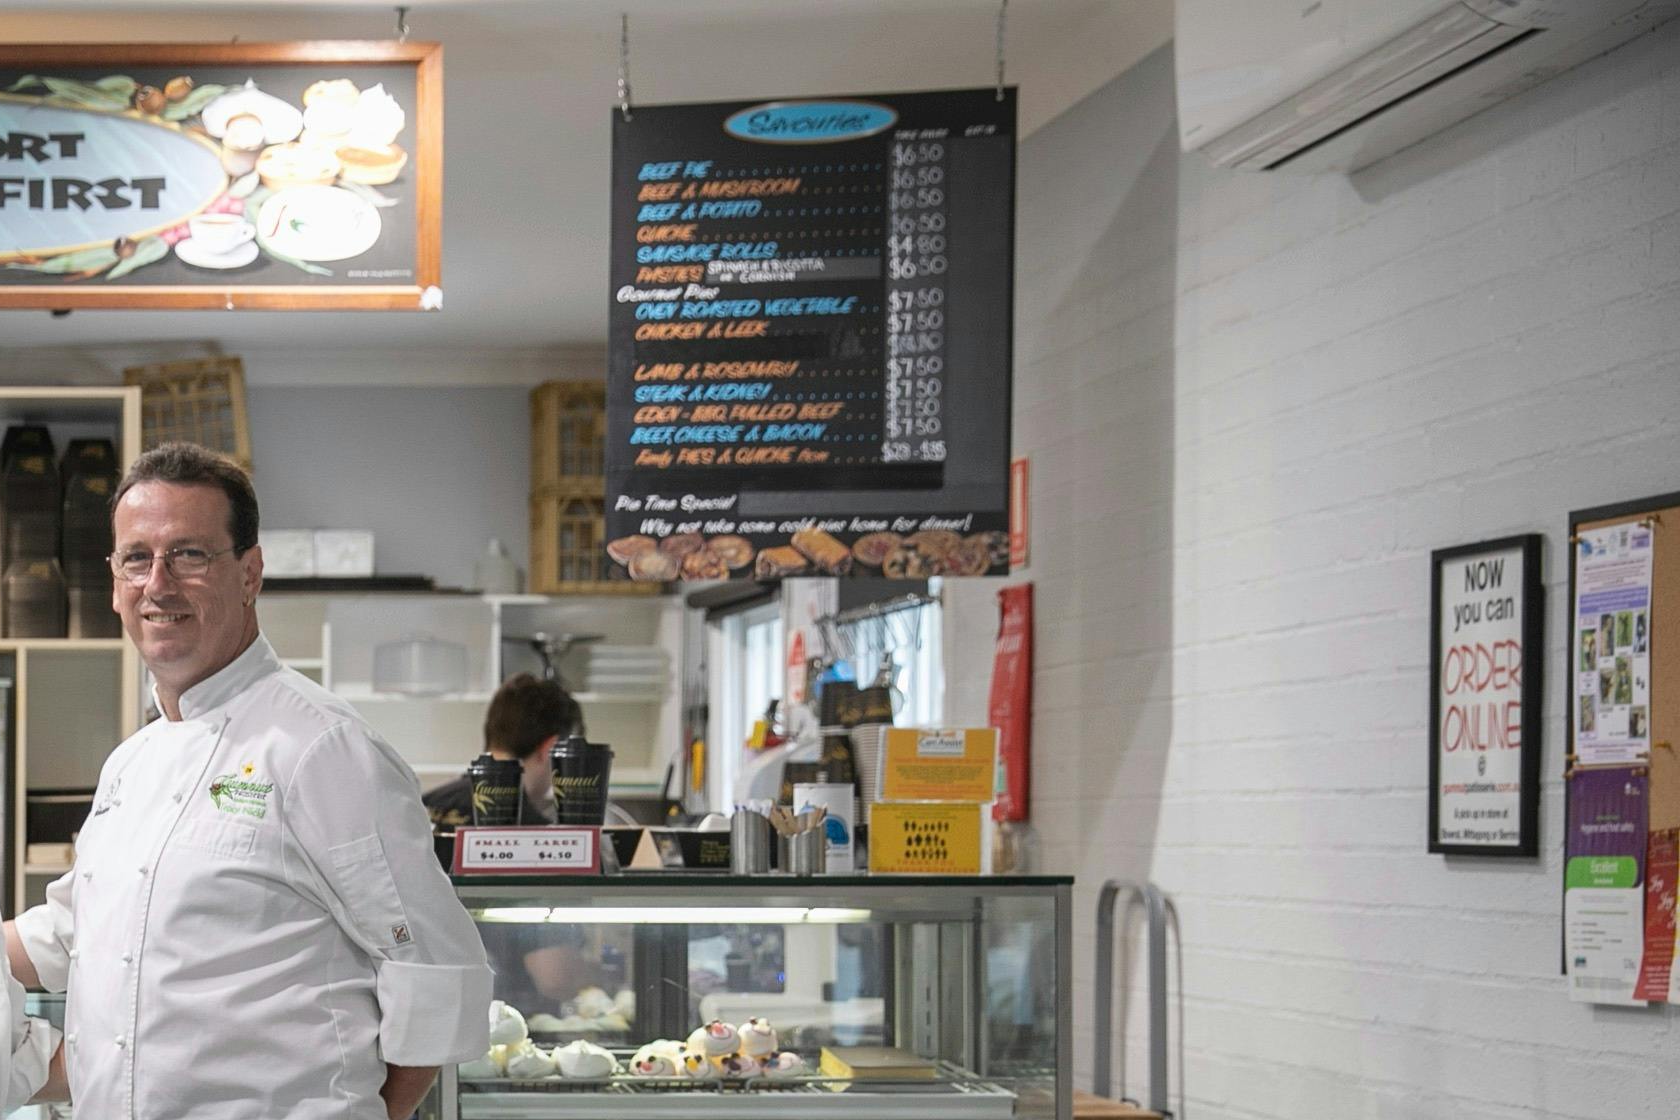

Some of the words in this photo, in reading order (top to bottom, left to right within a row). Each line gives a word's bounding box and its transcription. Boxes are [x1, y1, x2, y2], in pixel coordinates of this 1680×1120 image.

[747, 109, 870, 135] Savouries
[638, 161, 682, 181] BEEF
[683, 160, 714, 179] PIE
[638, 182, 682, 201] BEEF
[699, 177, 801, 198] MUSHROOM
[637, 202, 681, 222] BEEF
[698, 200, 762, 220] POTATO
[636, 223, 699, 244] QUICHE
[636, 243, 719, 264] SAUSAGE
[719, 241, 779, 260] ROLLS
[636, 264, 705, 284] PASTIES
[617, 285, 683, 303] Gourmet
[634, 301, 680, 320] OVEN
[680, 299, 761, 318] ROASTED
[764, 296, 858, 316] VEGETABLE
[634, 321, 707, 341] CHICKEN
[724, 319, 769, 338] LEEK
[634, 362, 685, 382] LAMB
[702, 359, 801, 378] ROSEMARY
[634, 383, 690, 403] STEAK
[704, 382, 773, 401] KIDNEY
[633, 405, 682, 424] EDEN
[690, 403, 729, 423] BBQ
[729, 402, 798, 422] PULLED
[797, 401, 846, 420] BEEF
[674, 424, 744, 444] CHEESE
[762, 423, 827, 442] BACON
[676, 446, 716, 466] PIES
[734, 445, 797, 464] QUICHE
[614, 494, 643, 512] Pie
[644, 494, 679, 512] Time
[680, 493, 738, 514] Special
[639, 518, 674, 537] Why
[737, 521, 777, 534] some
[848, 516, 890, 533] home
[890, 515, 920, 532] for
[1465, 558, 1504, 592] NOW
[1453, 600, 1481, 633] you
[1485, 597, 1514, 622] can
[1442, 640, 1522, 695] ORDER
[1442, 701, 1521, 752] ONLINE
[474, 839, 520, 847] SMALL
[533, 839, 578, 847] LARGE
[480, 851, 514, 861] $4.00
[538, 851, 572, 861] $4.50
